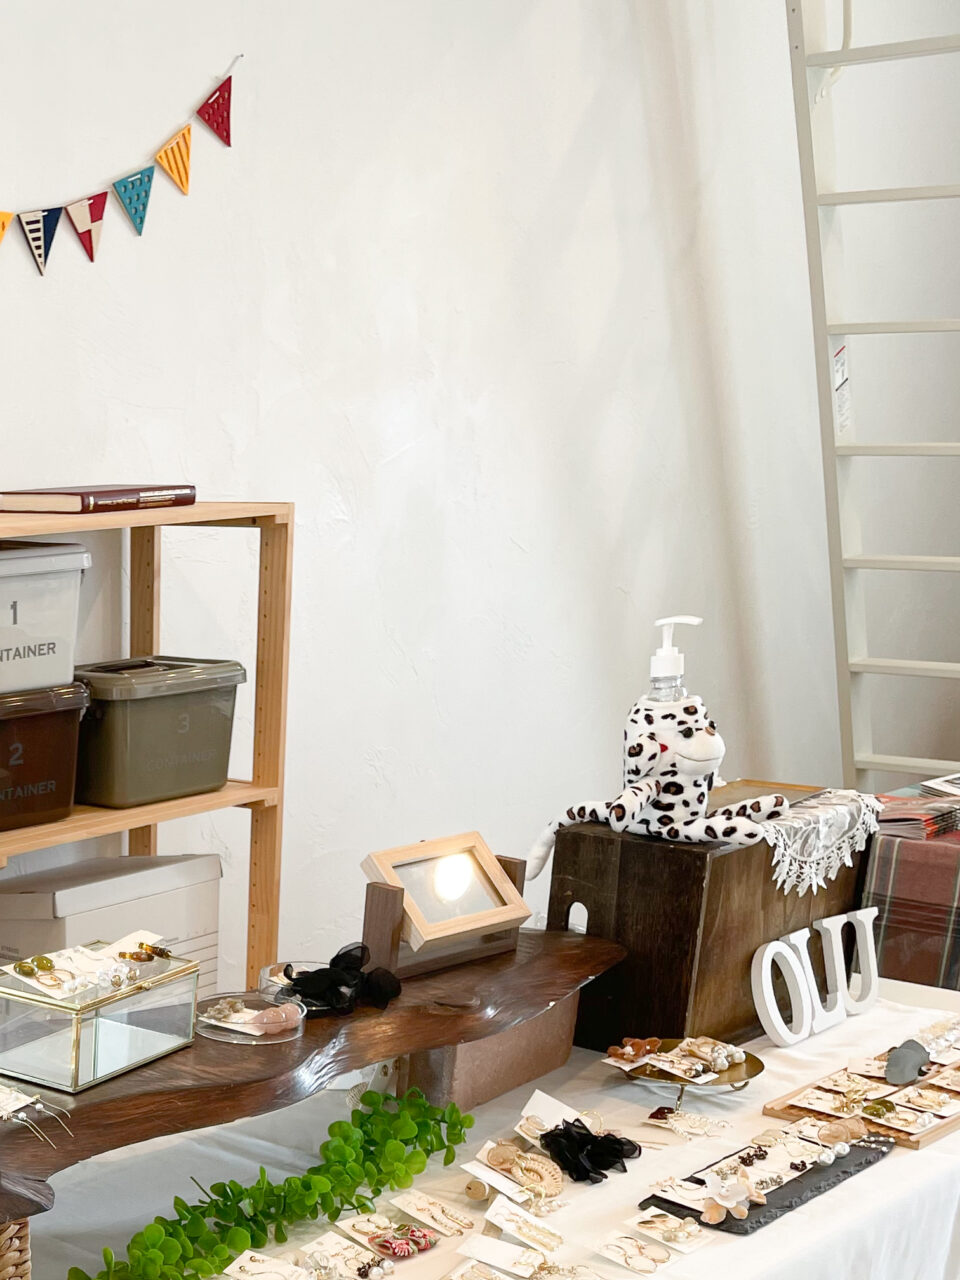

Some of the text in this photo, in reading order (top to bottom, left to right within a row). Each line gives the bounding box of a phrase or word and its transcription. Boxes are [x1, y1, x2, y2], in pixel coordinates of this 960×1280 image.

[10, 601, 19, 626] 1
[177, 712, 191, 734] 3
[9, 743, 25, 767] 2
